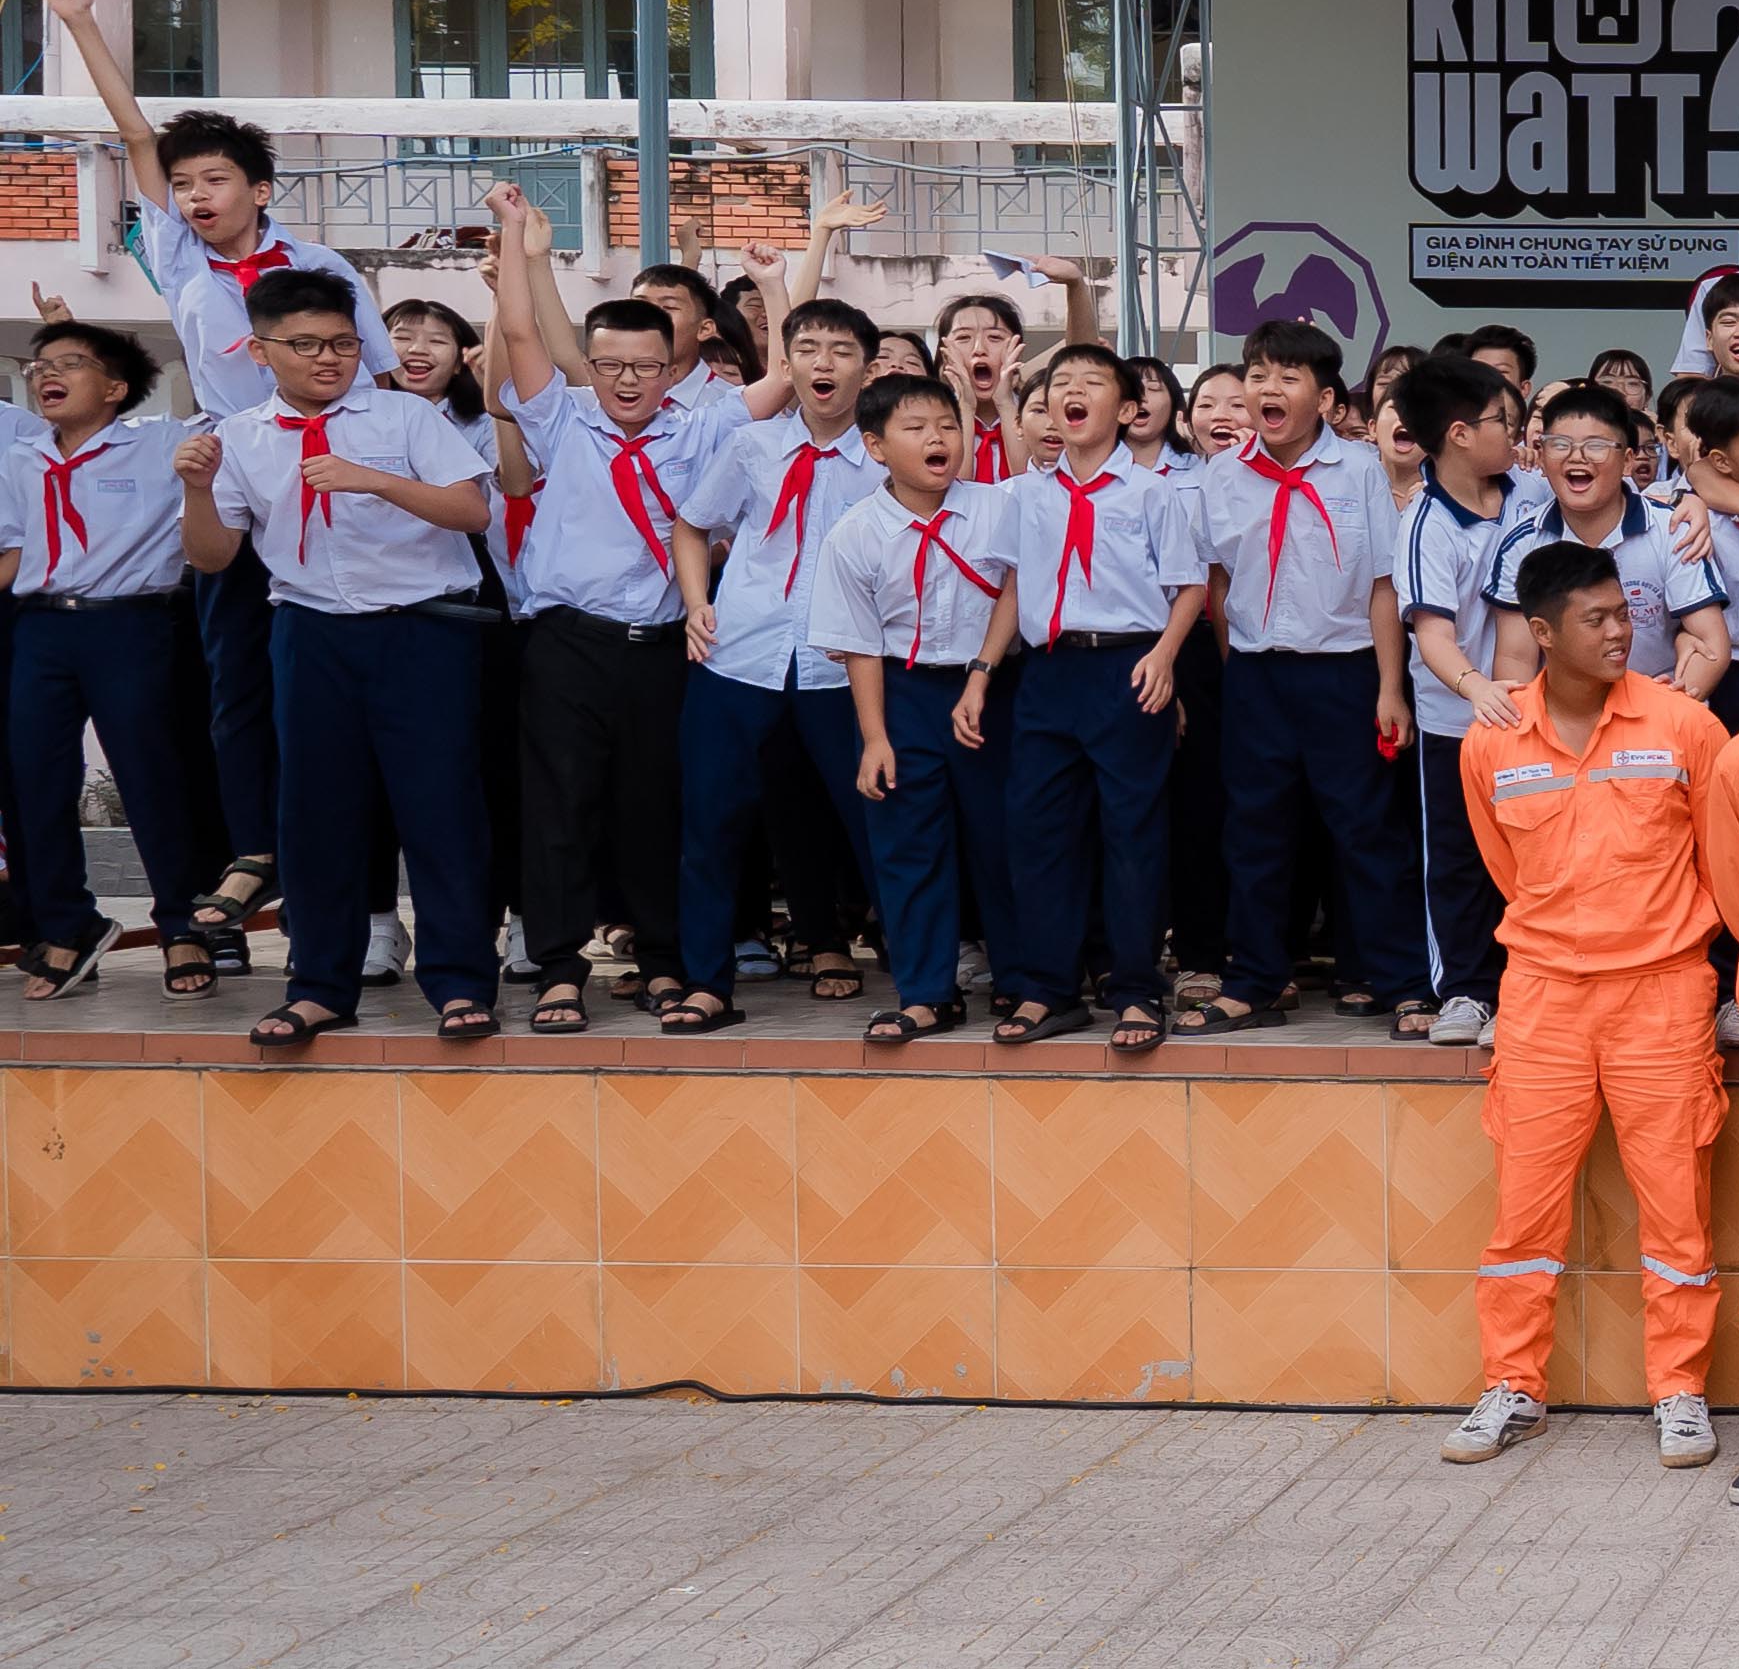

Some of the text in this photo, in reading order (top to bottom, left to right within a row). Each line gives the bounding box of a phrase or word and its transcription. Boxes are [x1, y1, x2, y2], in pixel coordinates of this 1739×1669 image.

[1425, 234, 1728, 256] GIA ĐÌNH CHUNG TAY SỬ DỤNG
[1426, 250, 1670, 274] ĐIỆN AN TOÀN TIẾT KIỆM
